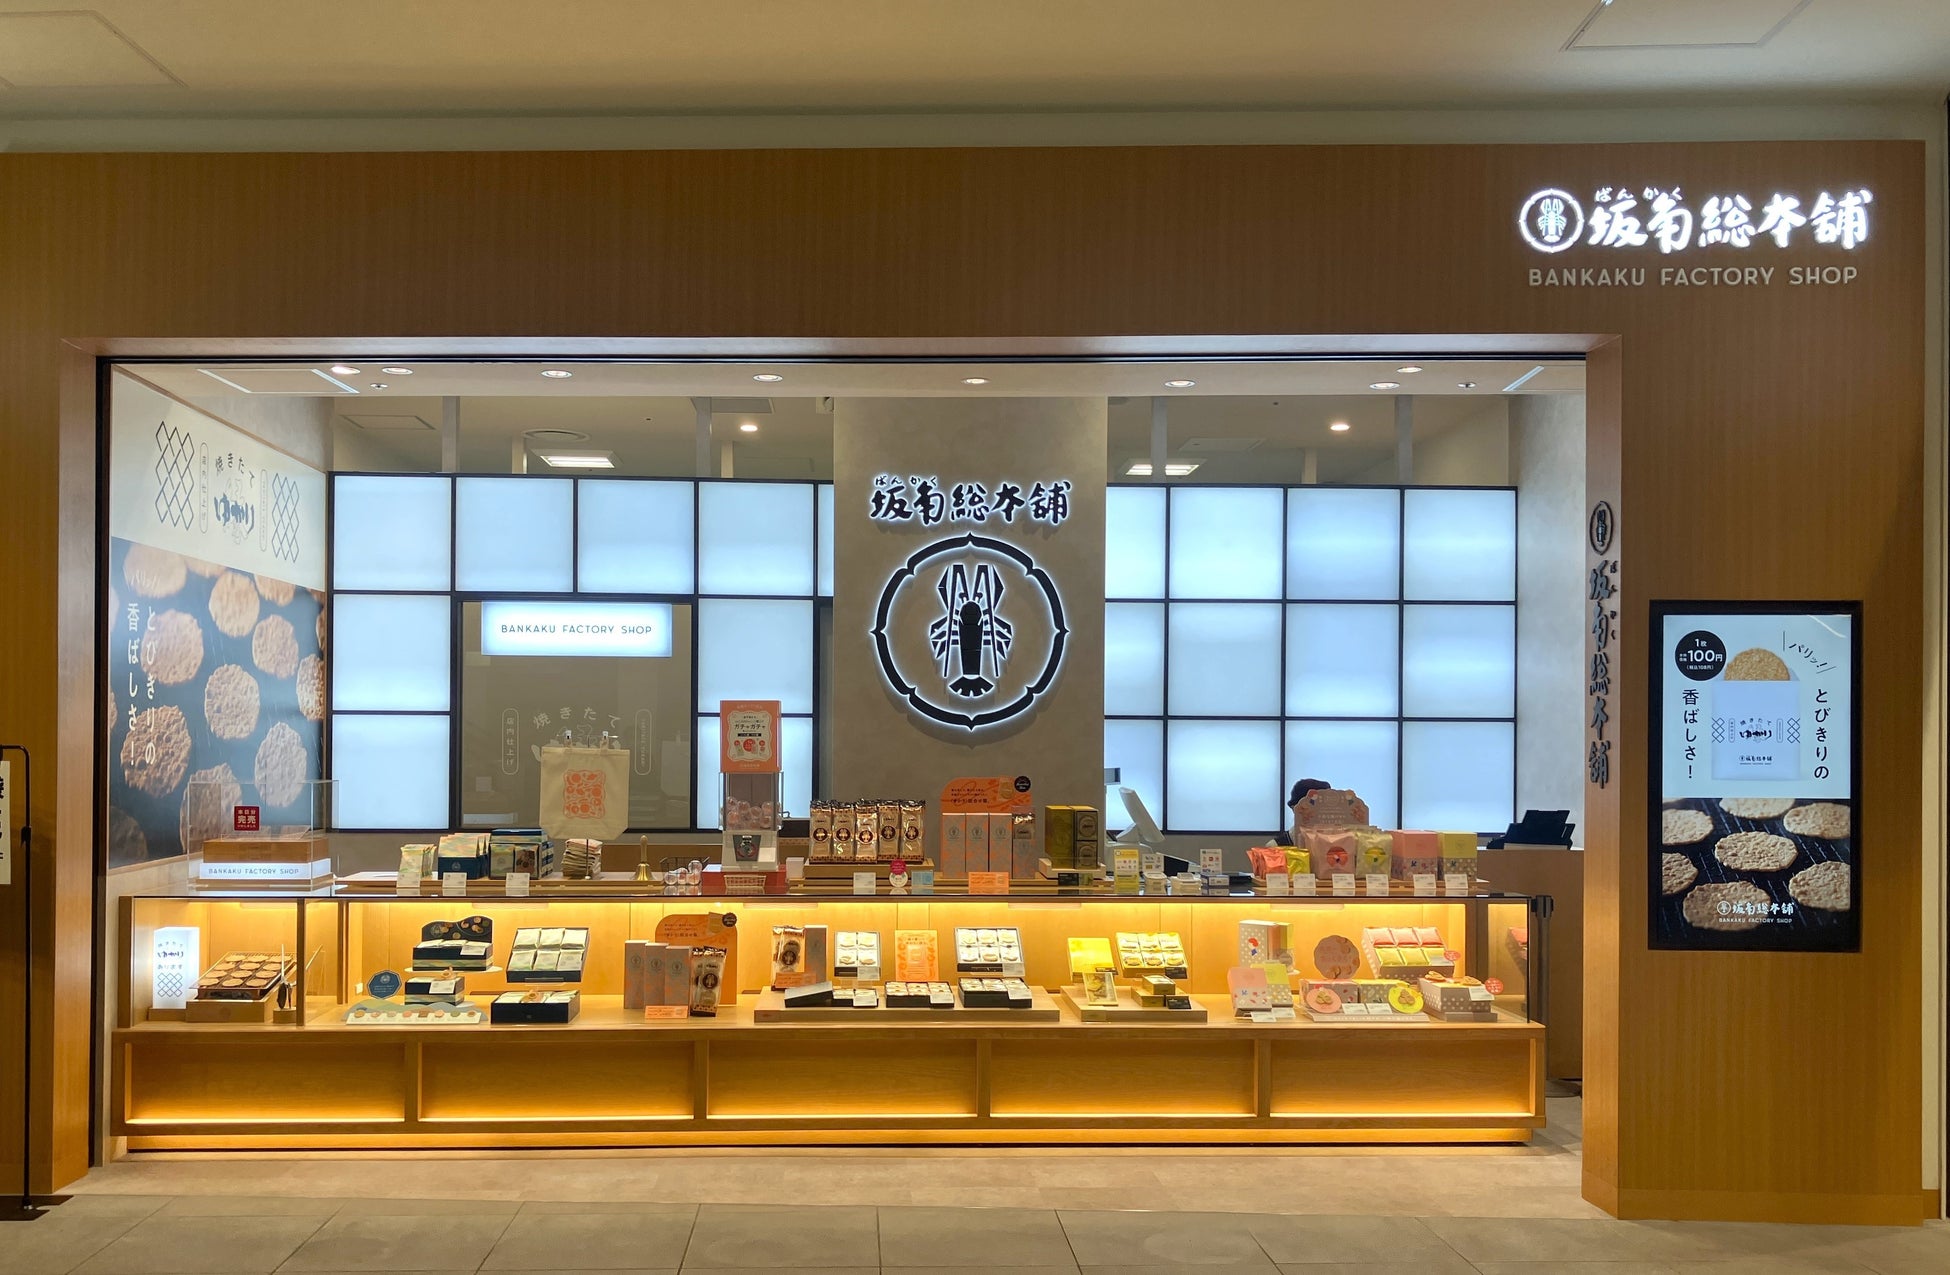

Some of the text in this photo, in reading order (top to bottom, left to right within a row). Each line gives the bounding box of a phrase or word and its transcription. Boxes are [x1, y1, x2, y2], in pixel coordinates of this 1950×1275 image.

[1528, 266, 1859, 287] BANKAKU FACTORY SHOP
[501, 624, 652, 635] BANKAKU FACTORY SHOP
[1694, 638, 1707, 647] 1枚
[127, 602, 141, 766] 香ばしさ！
[145, 605, 158, 765] とびきりの
[533, 706, 621, 729] 焼きたて
[1682, 688, 1700, 779] 香ばしさ！
[1814, 688, 1831, 779] とびきりの
